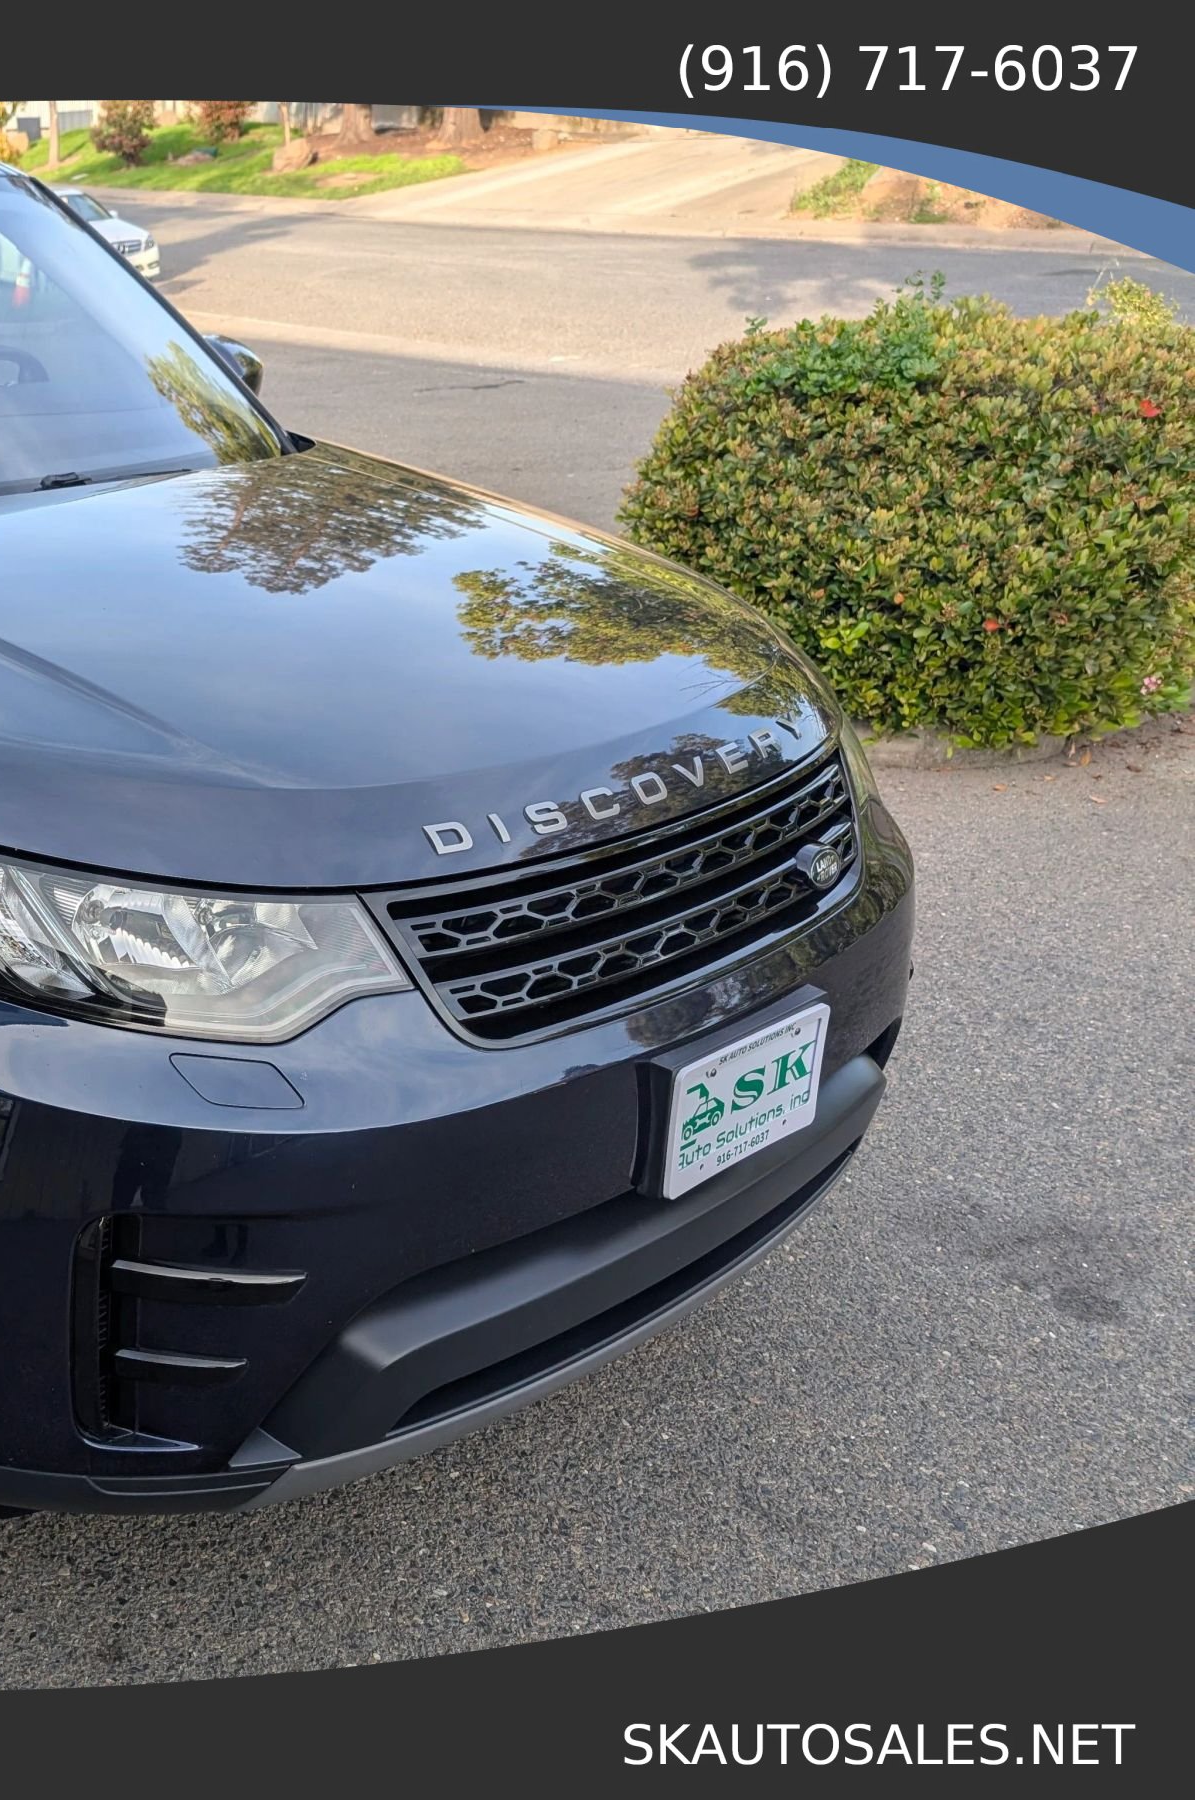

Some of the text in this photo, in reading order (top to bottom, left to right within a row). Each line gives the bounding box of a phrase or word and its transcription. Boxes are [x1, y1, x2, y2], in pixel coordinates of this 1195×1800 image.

[422, 711, 803, 855] DISCOVERY
[816, 856, 832, 873] LAND
[819, 862, 838, 882] ROVER
[719, 1022, 796, 1065] SK AUTO SOLUTIONS INC
[730, 1040, 817, 1114] SK
[716, 1129, 770, 1167] 916-717-6037
